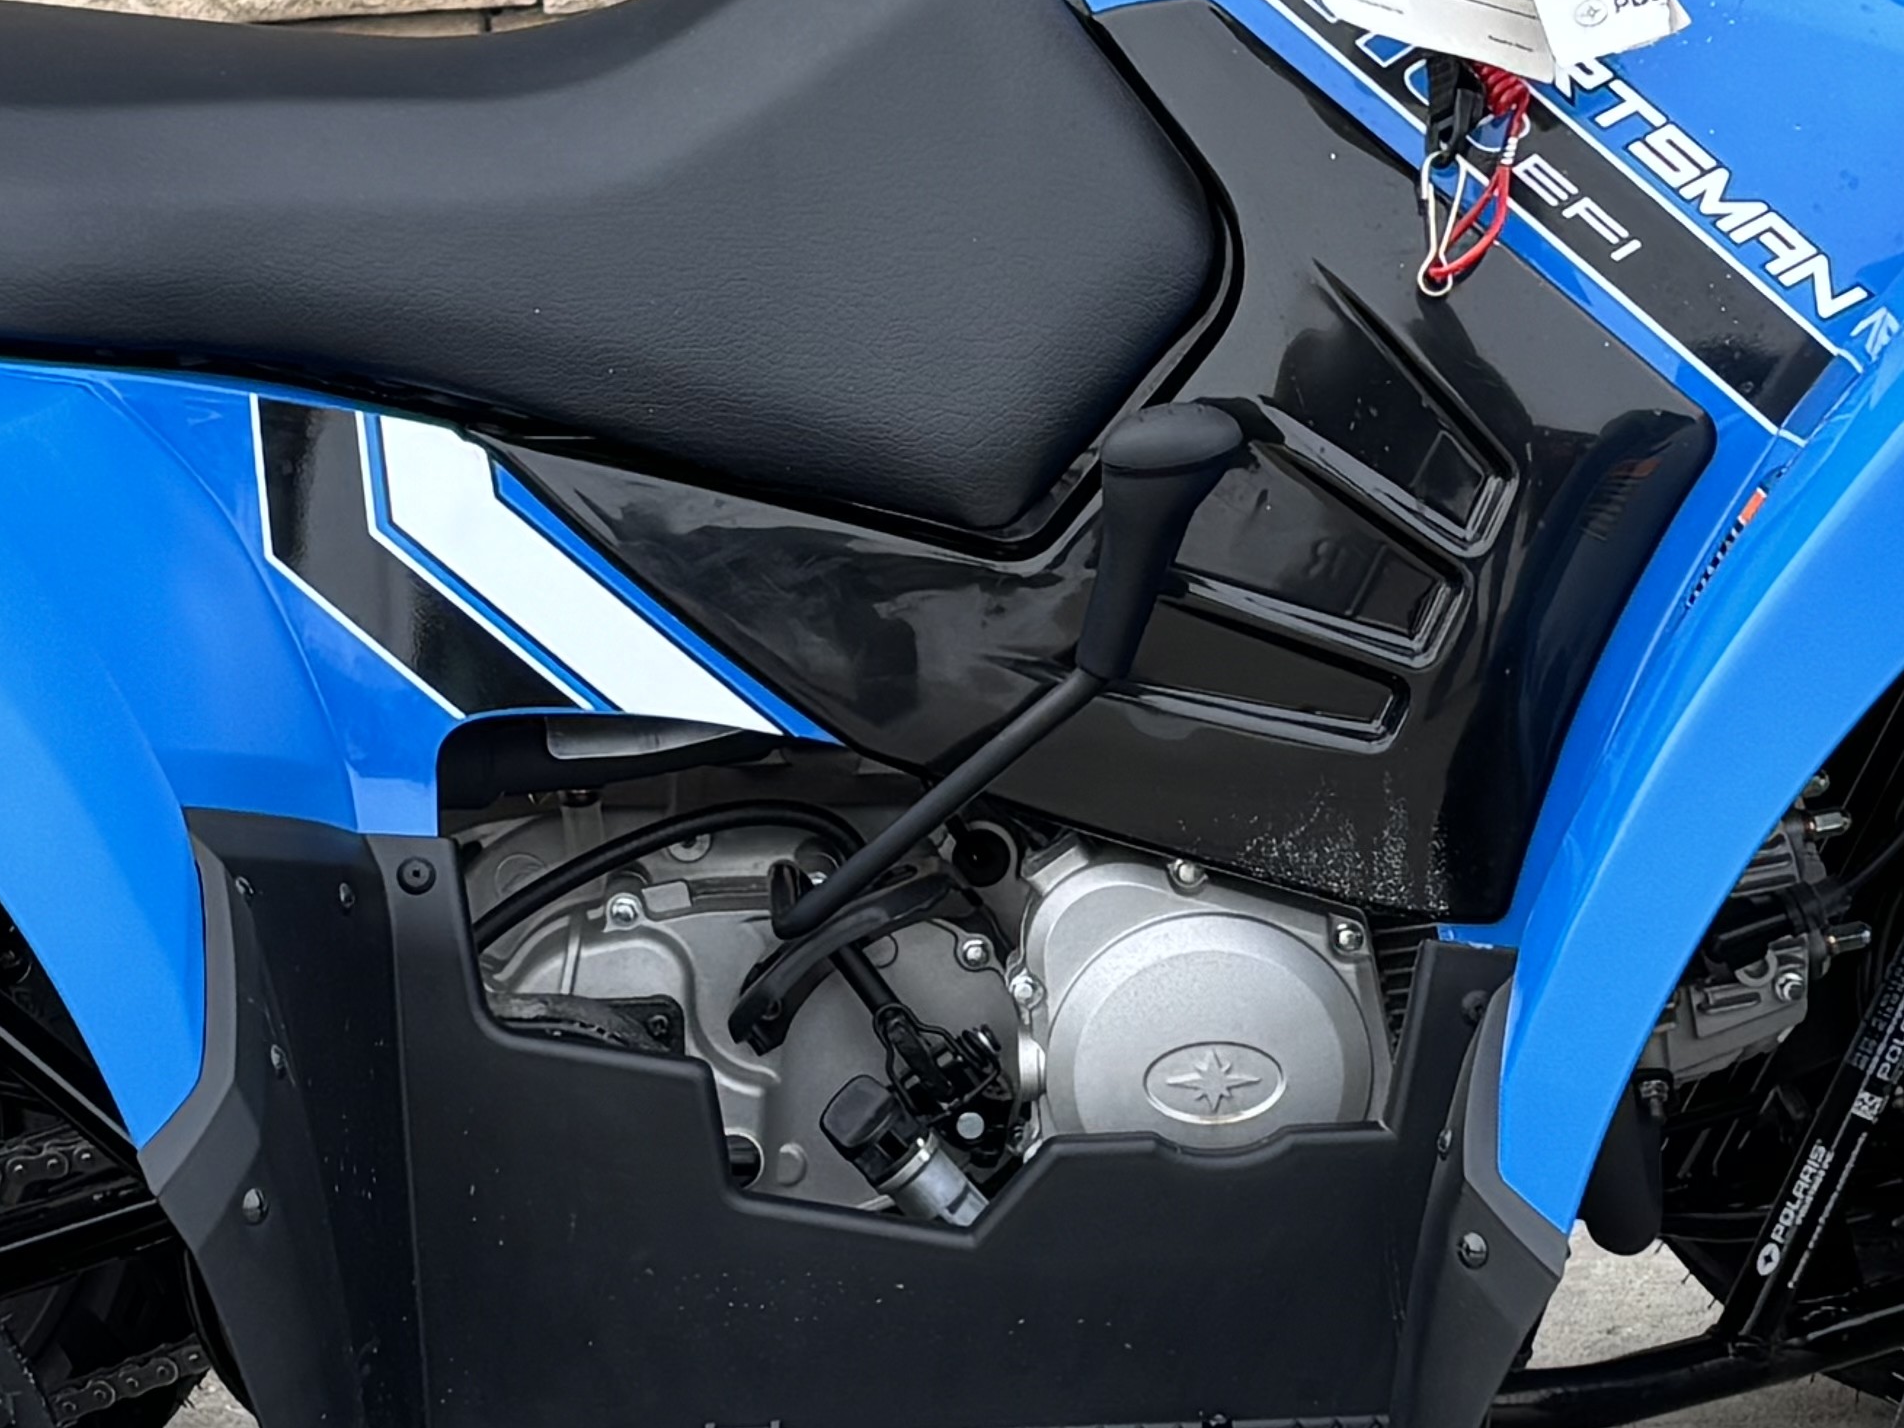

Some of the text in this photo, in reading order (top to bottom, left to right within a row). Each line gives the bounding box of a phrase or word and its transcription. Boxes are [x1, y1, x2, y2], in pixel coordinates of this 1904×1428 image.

[1512, 153, 1642, 262] EFI
[1553, 56, 1871, 320] RTSMAN
[1768, 1141, 1828, 1245] POLARIS
